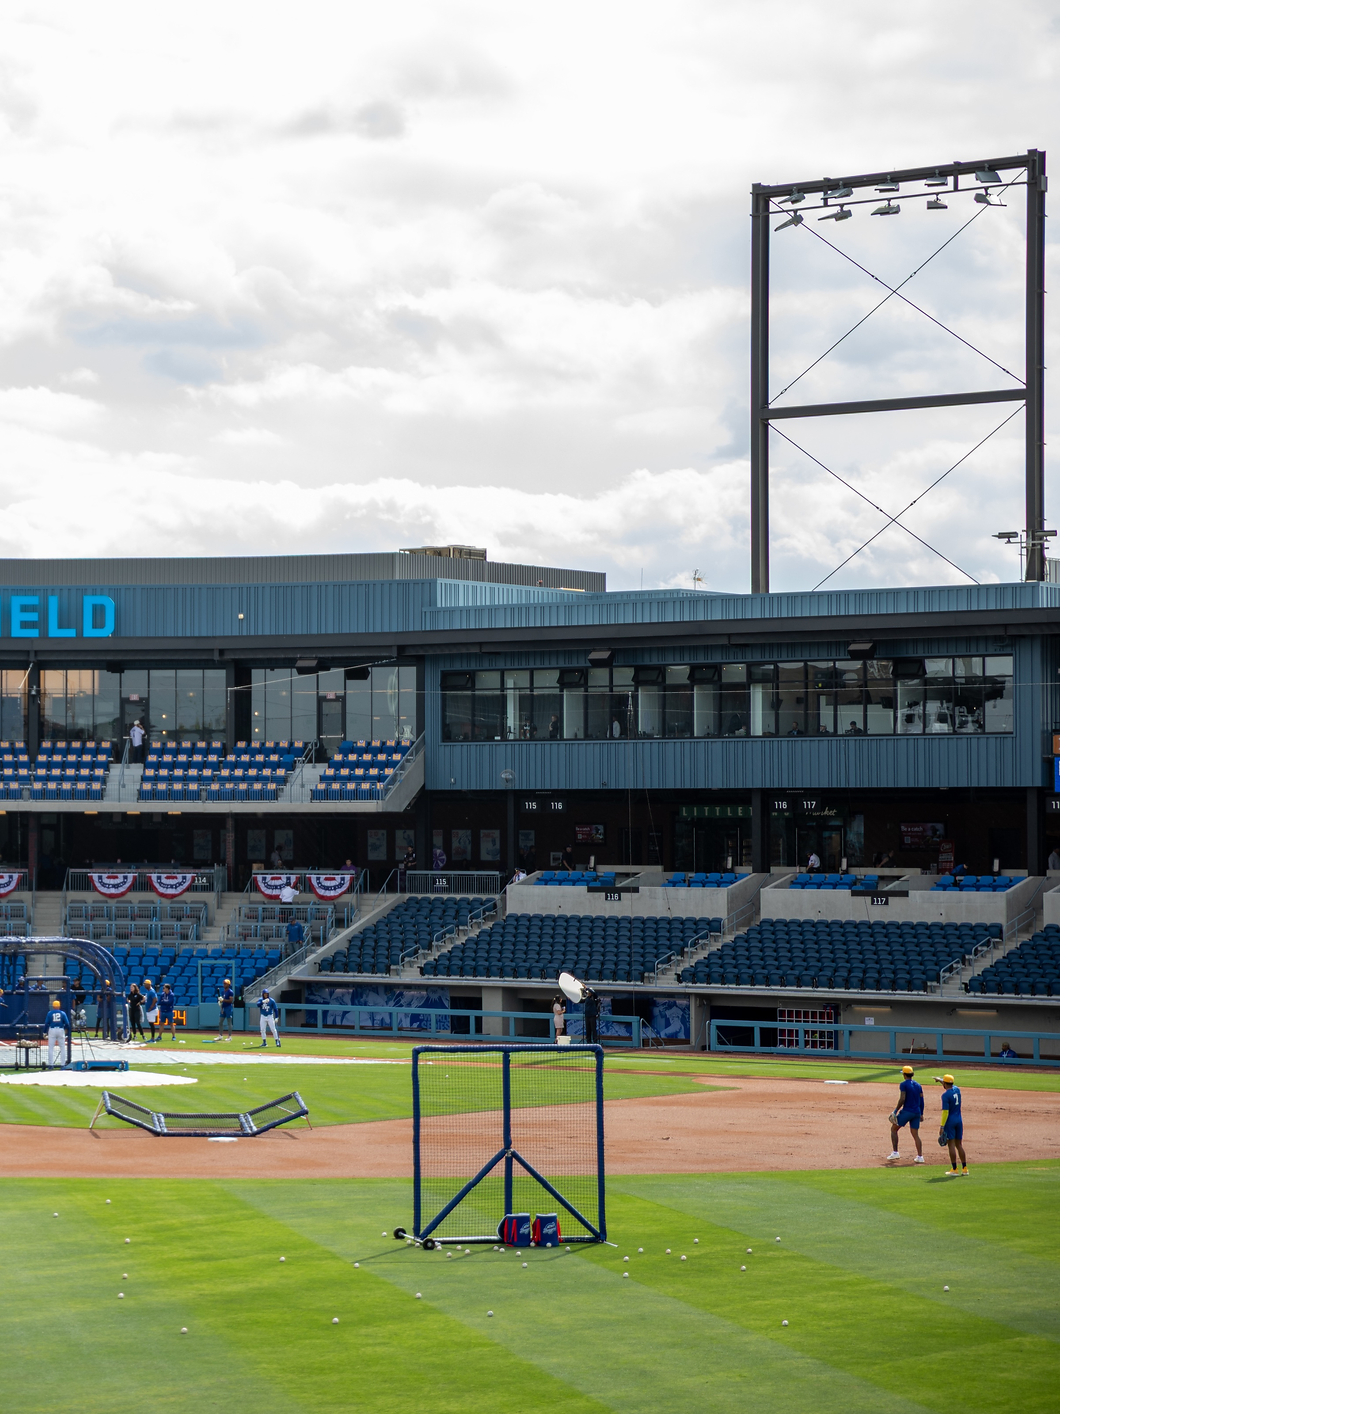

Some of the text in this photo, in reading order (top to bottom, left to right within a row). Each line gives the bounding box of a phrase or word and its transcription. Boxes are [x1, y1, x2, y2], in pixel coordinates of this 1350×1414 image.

[525, 802, 563, 810] 115 116
[774, 801, 817, 810] 116 117
[194, 876, 207, 884] 114
[873, 897, 886, 905] 117
[52, 1012, 61, 1022] 12
[953, 1093, 960, 1106] 7
